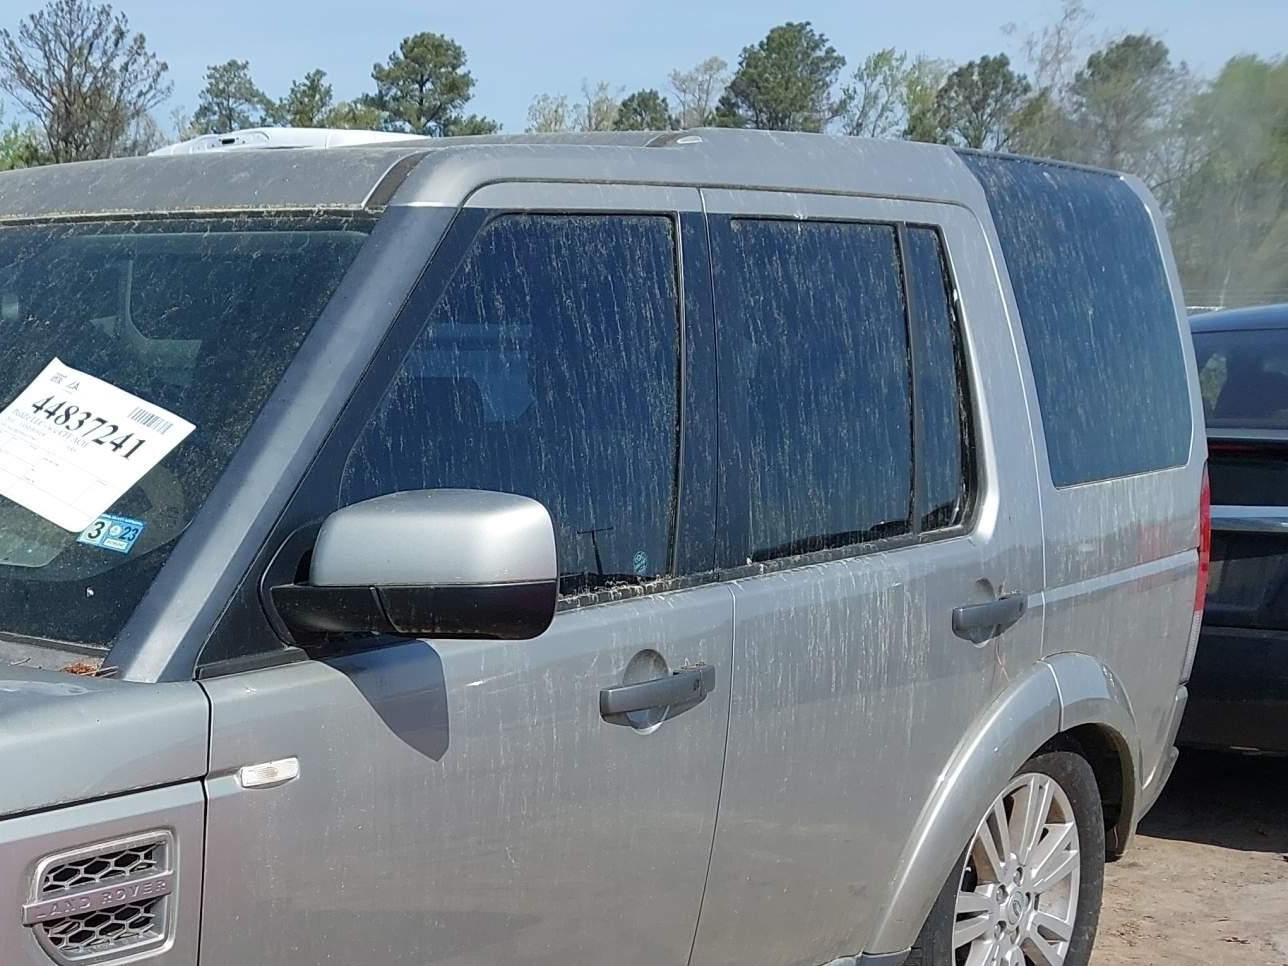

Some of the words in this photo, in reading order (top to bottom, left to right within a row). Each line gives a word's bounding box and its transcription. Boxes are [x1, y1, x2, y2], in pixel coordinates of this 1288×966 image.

[31, 394, 147, 461] 44837241
[87, 520, 106, 540] 3
[118, 525, 140, 542] 23
[35, 896, 92, 920] LAND
[101, 880, 167, 905] ROVER
